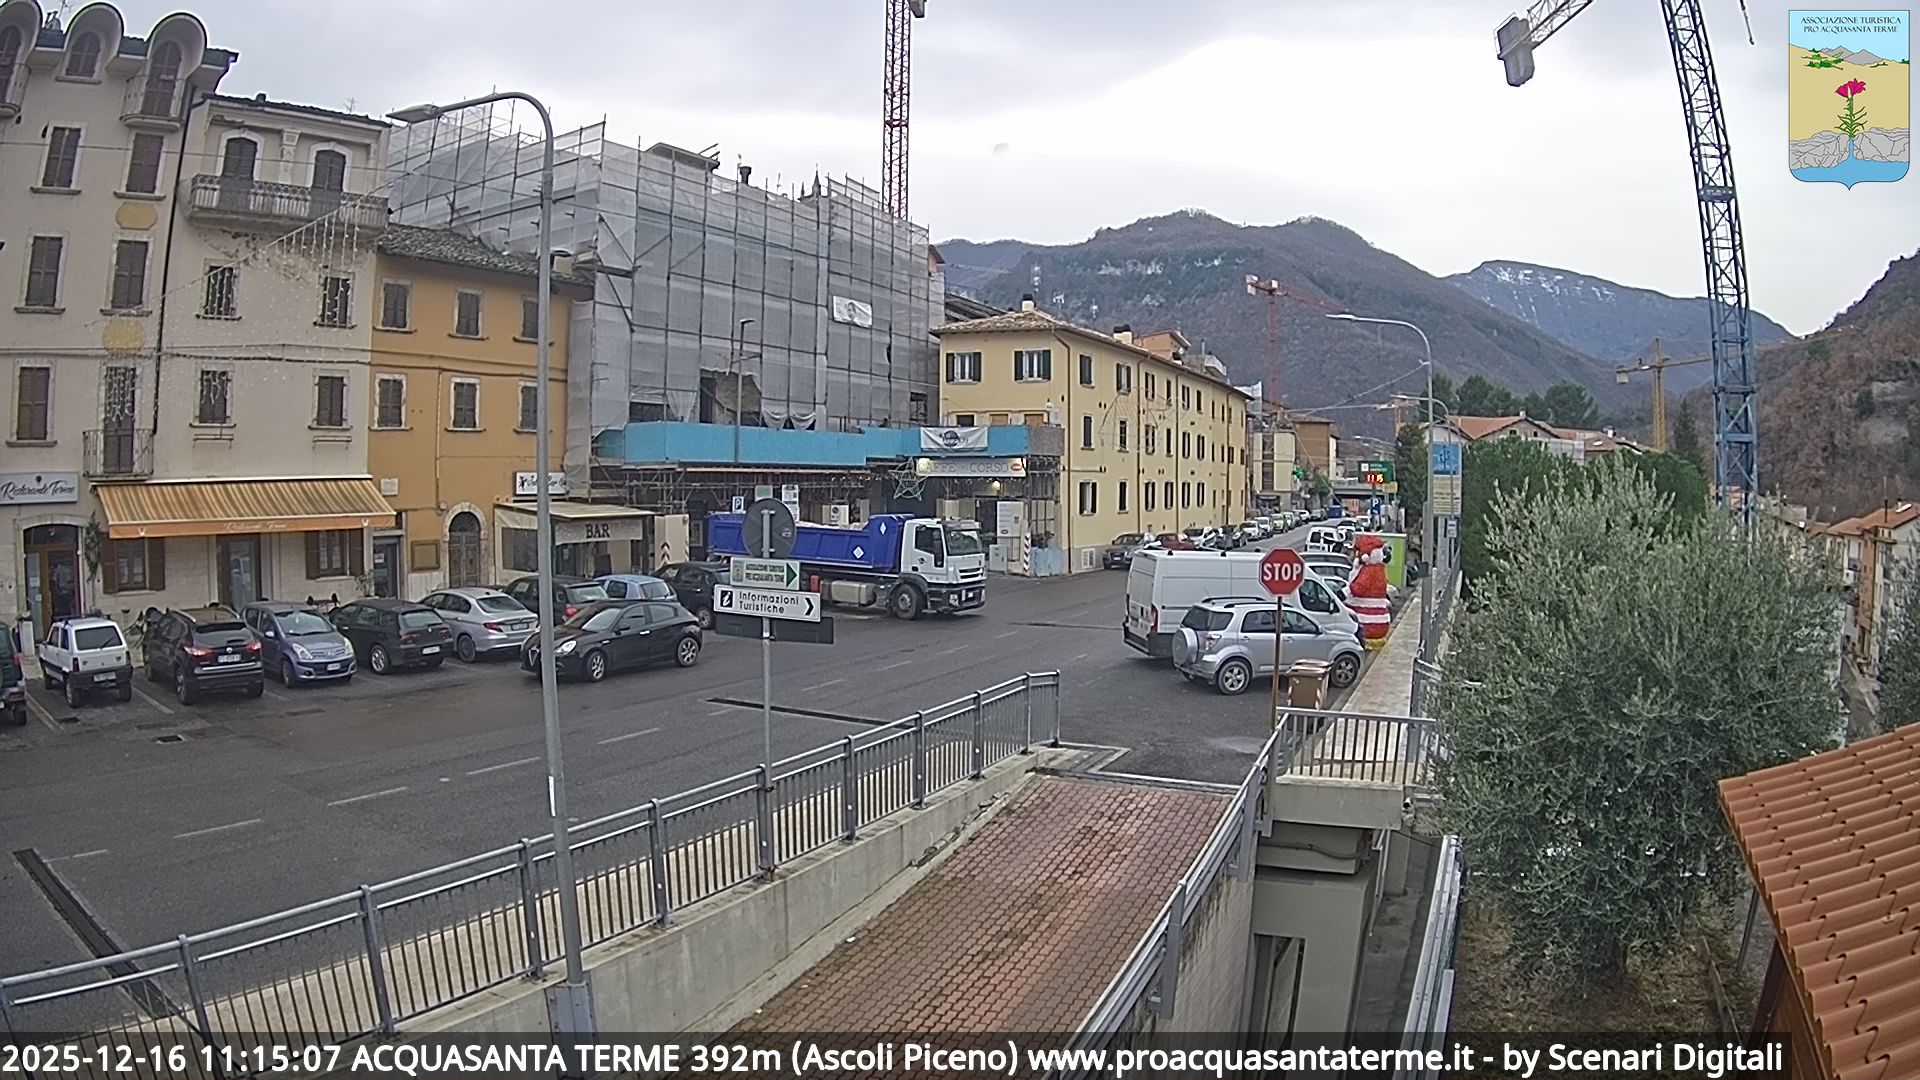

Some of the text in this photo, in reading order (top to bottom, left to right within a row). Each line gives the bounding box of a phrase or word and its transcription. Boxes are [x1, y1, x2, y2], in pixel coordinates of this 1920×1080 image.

[969, 462, 1009, 473] CORSO
[585, 523, 610, 539] BAR
[1263, 563, 1302, 581] STOP
[739, 591, 799, 606] Informazioni
[739, 600, 785, 614] Turistiche
